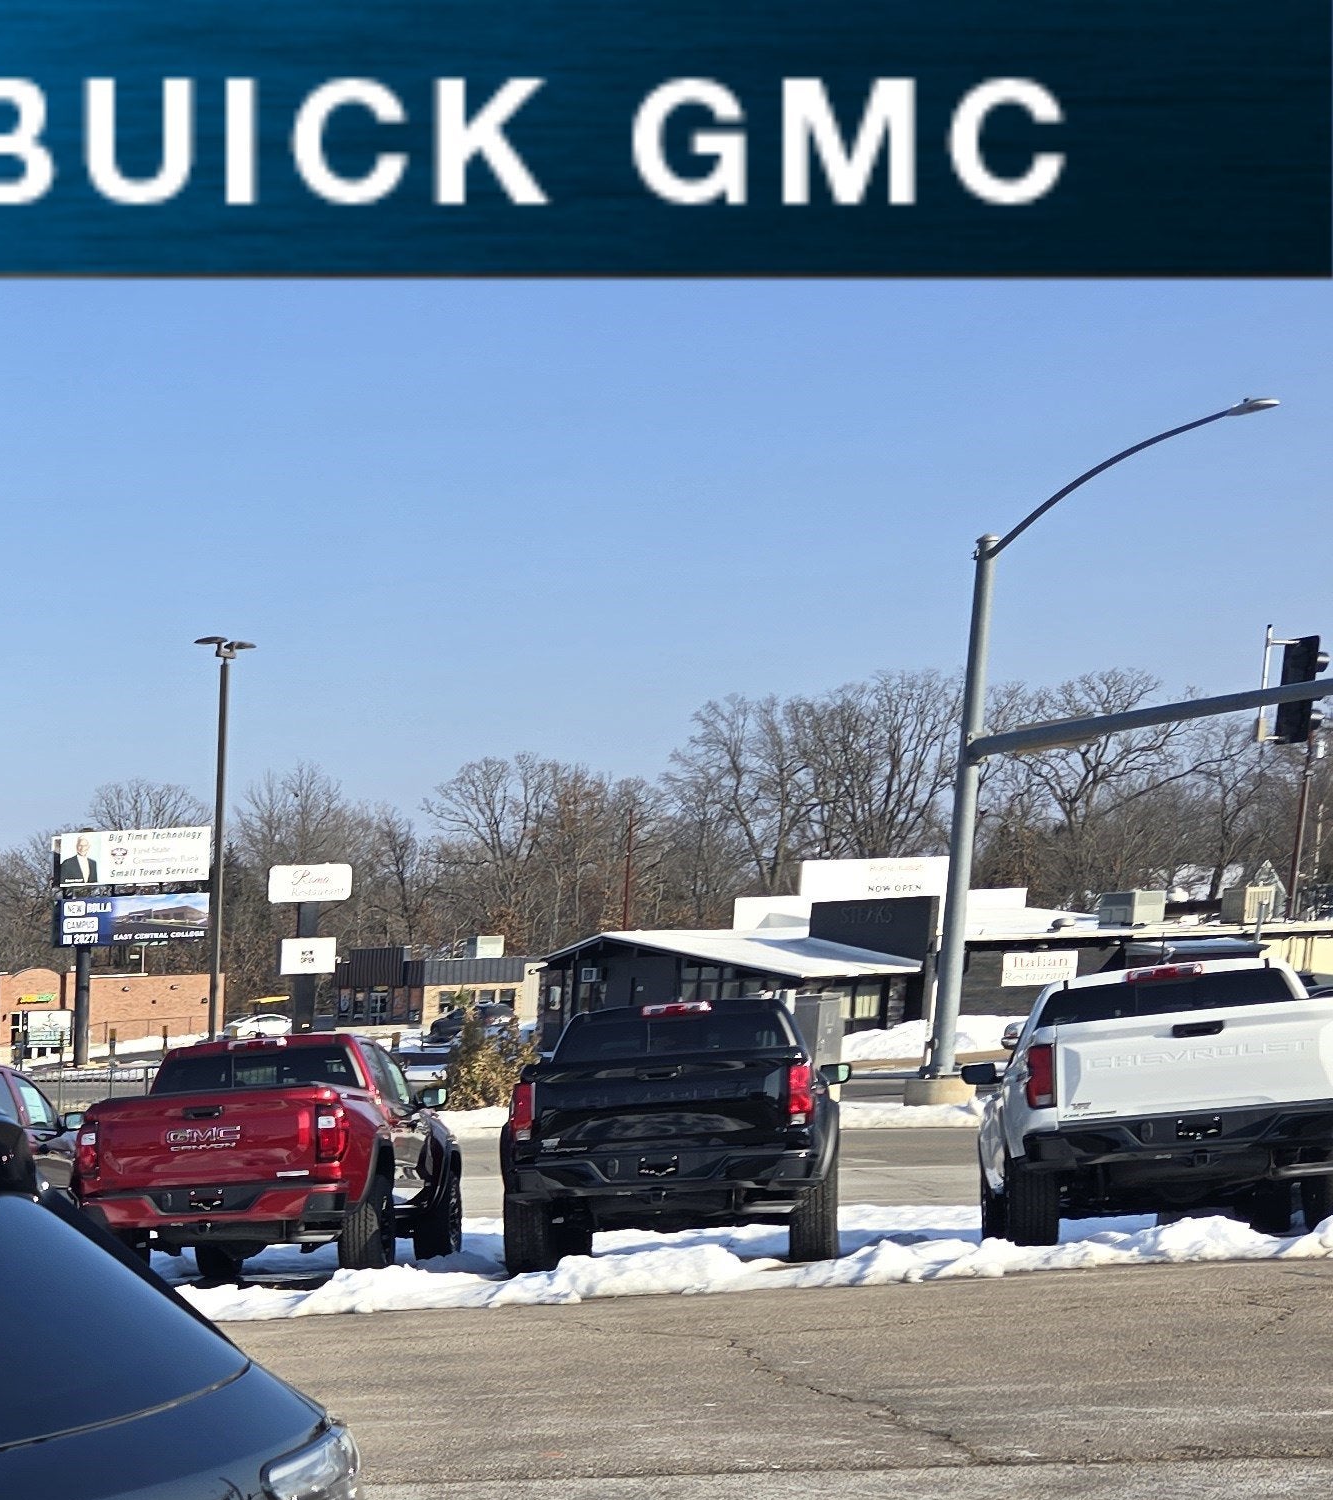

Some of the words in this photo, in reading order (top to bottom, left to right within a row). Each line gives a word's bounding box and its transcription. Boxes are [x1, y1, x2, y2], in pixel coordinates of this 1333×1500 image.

[109, 834, 123, 843] Big
[127, 832, 148, 841] Time
[152, 830, 202, 840] Technology
[110, 868, 136, 877] Small
[140, 868, 162, 876] Town
[165, 867, 199, 875] Service
[867, 885, 891, 893] NOW
[894, 884, 923, 892] OPEN
[66, 920, 95, 930] CAMPUS
[134, 932, 169, 940] CENTRAL
[170, 930, 205, 938] COLLEGE
[1013, 957, 1068, 968] Italian
[1085, 1037, 1315, 1073] CHEVROLET
[166, 1125, 241, 1144] GMC
[169, 1142, 236, 1152] CANYON
